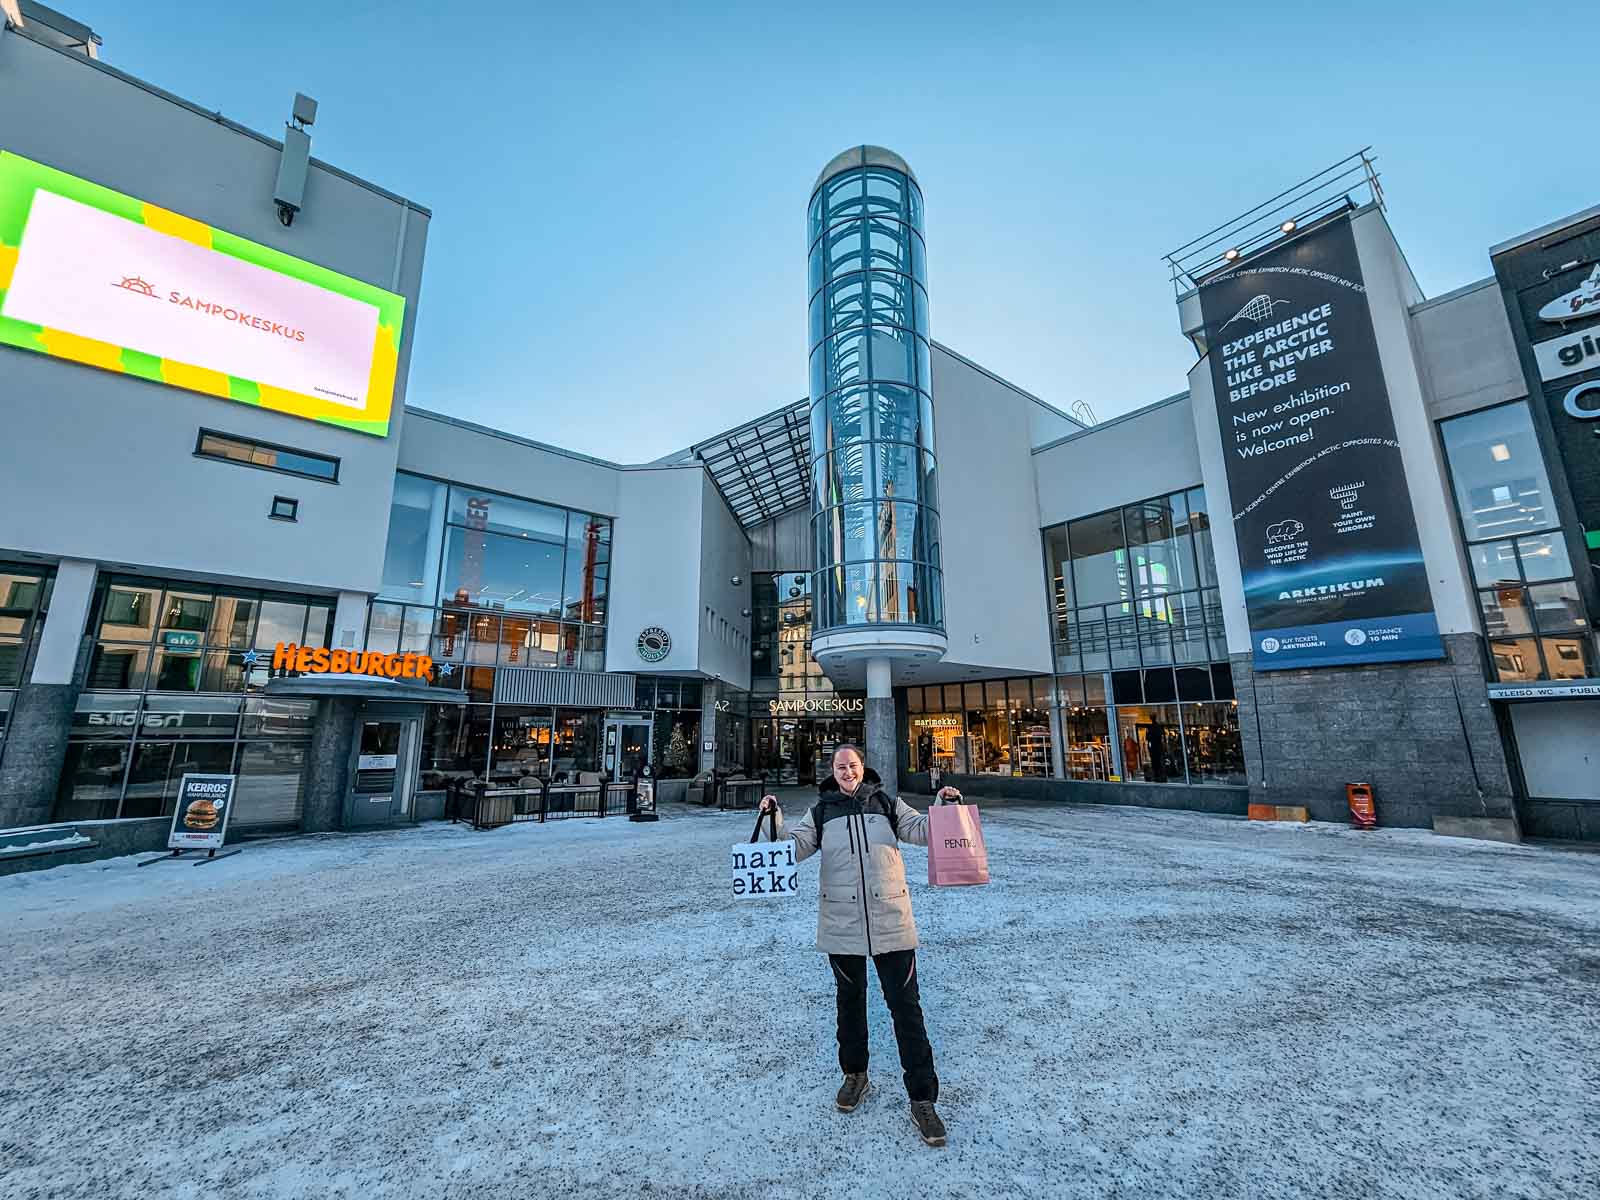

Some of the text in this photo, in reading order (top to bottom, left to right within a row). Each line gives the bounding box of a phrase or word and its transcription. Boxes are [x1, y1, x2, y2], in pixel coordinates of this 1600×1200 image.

[1290, 267, 1310, 275] ARCTIC
[1310, 270, 1338, 283] OPPOSITES
[168, 290, 306, 342] SAMPOKESKUS
[1222, 303, 1332, 357] EXPERIENCE
[1224, 323, 1329, 372] THE ARCTIC
[1227, 338, 1334, 387] LIKE NEVER
[1229, 369, 1296, 403] BEFORE
[1232, 381, 1351, 427] New exhibition
[1236, 405, 1335, 443] is now open.
[1238, 428, 1314, 459] Welcome!
[1285, 455, 1317, 479] EXHIBITION
[1317, 443, 1341, 458] ARCTIC
[1342, 437, 1382, 448] OPPOSITES
[1332, 515, 1376, 527] YOUR OWN
[1341, 511, 1364, 520] PAINT
[1337, 523, 1373, 533] AURORAS
[1264, 540, 1309, 554] DISCOVER THE
[1266, 547, 1308, 560] WILD LIFE OF
[1270, 554, 1307, 565] THE ARCTIC
[1278, 577, 1384, 601] ARKTIKUM
[1368, 627, 1402, 635] DISTANCE
[1382, 633, 1399, 641] MIN
[1281, 635, 1318, 644] BUY TICKETS
[1282, 641, 1326, 650] ARKTIKUM.FI
[273, 641, 433, 681] HESBURGER
[1538, 688, 1553, 696] WC
[714, 700, 730, 712] A2
[769, 698, 863, 712] SAMPOKESKUS
[914, 718, 957, 726] marimekko
[187, 782, 228, 793] KERROS
